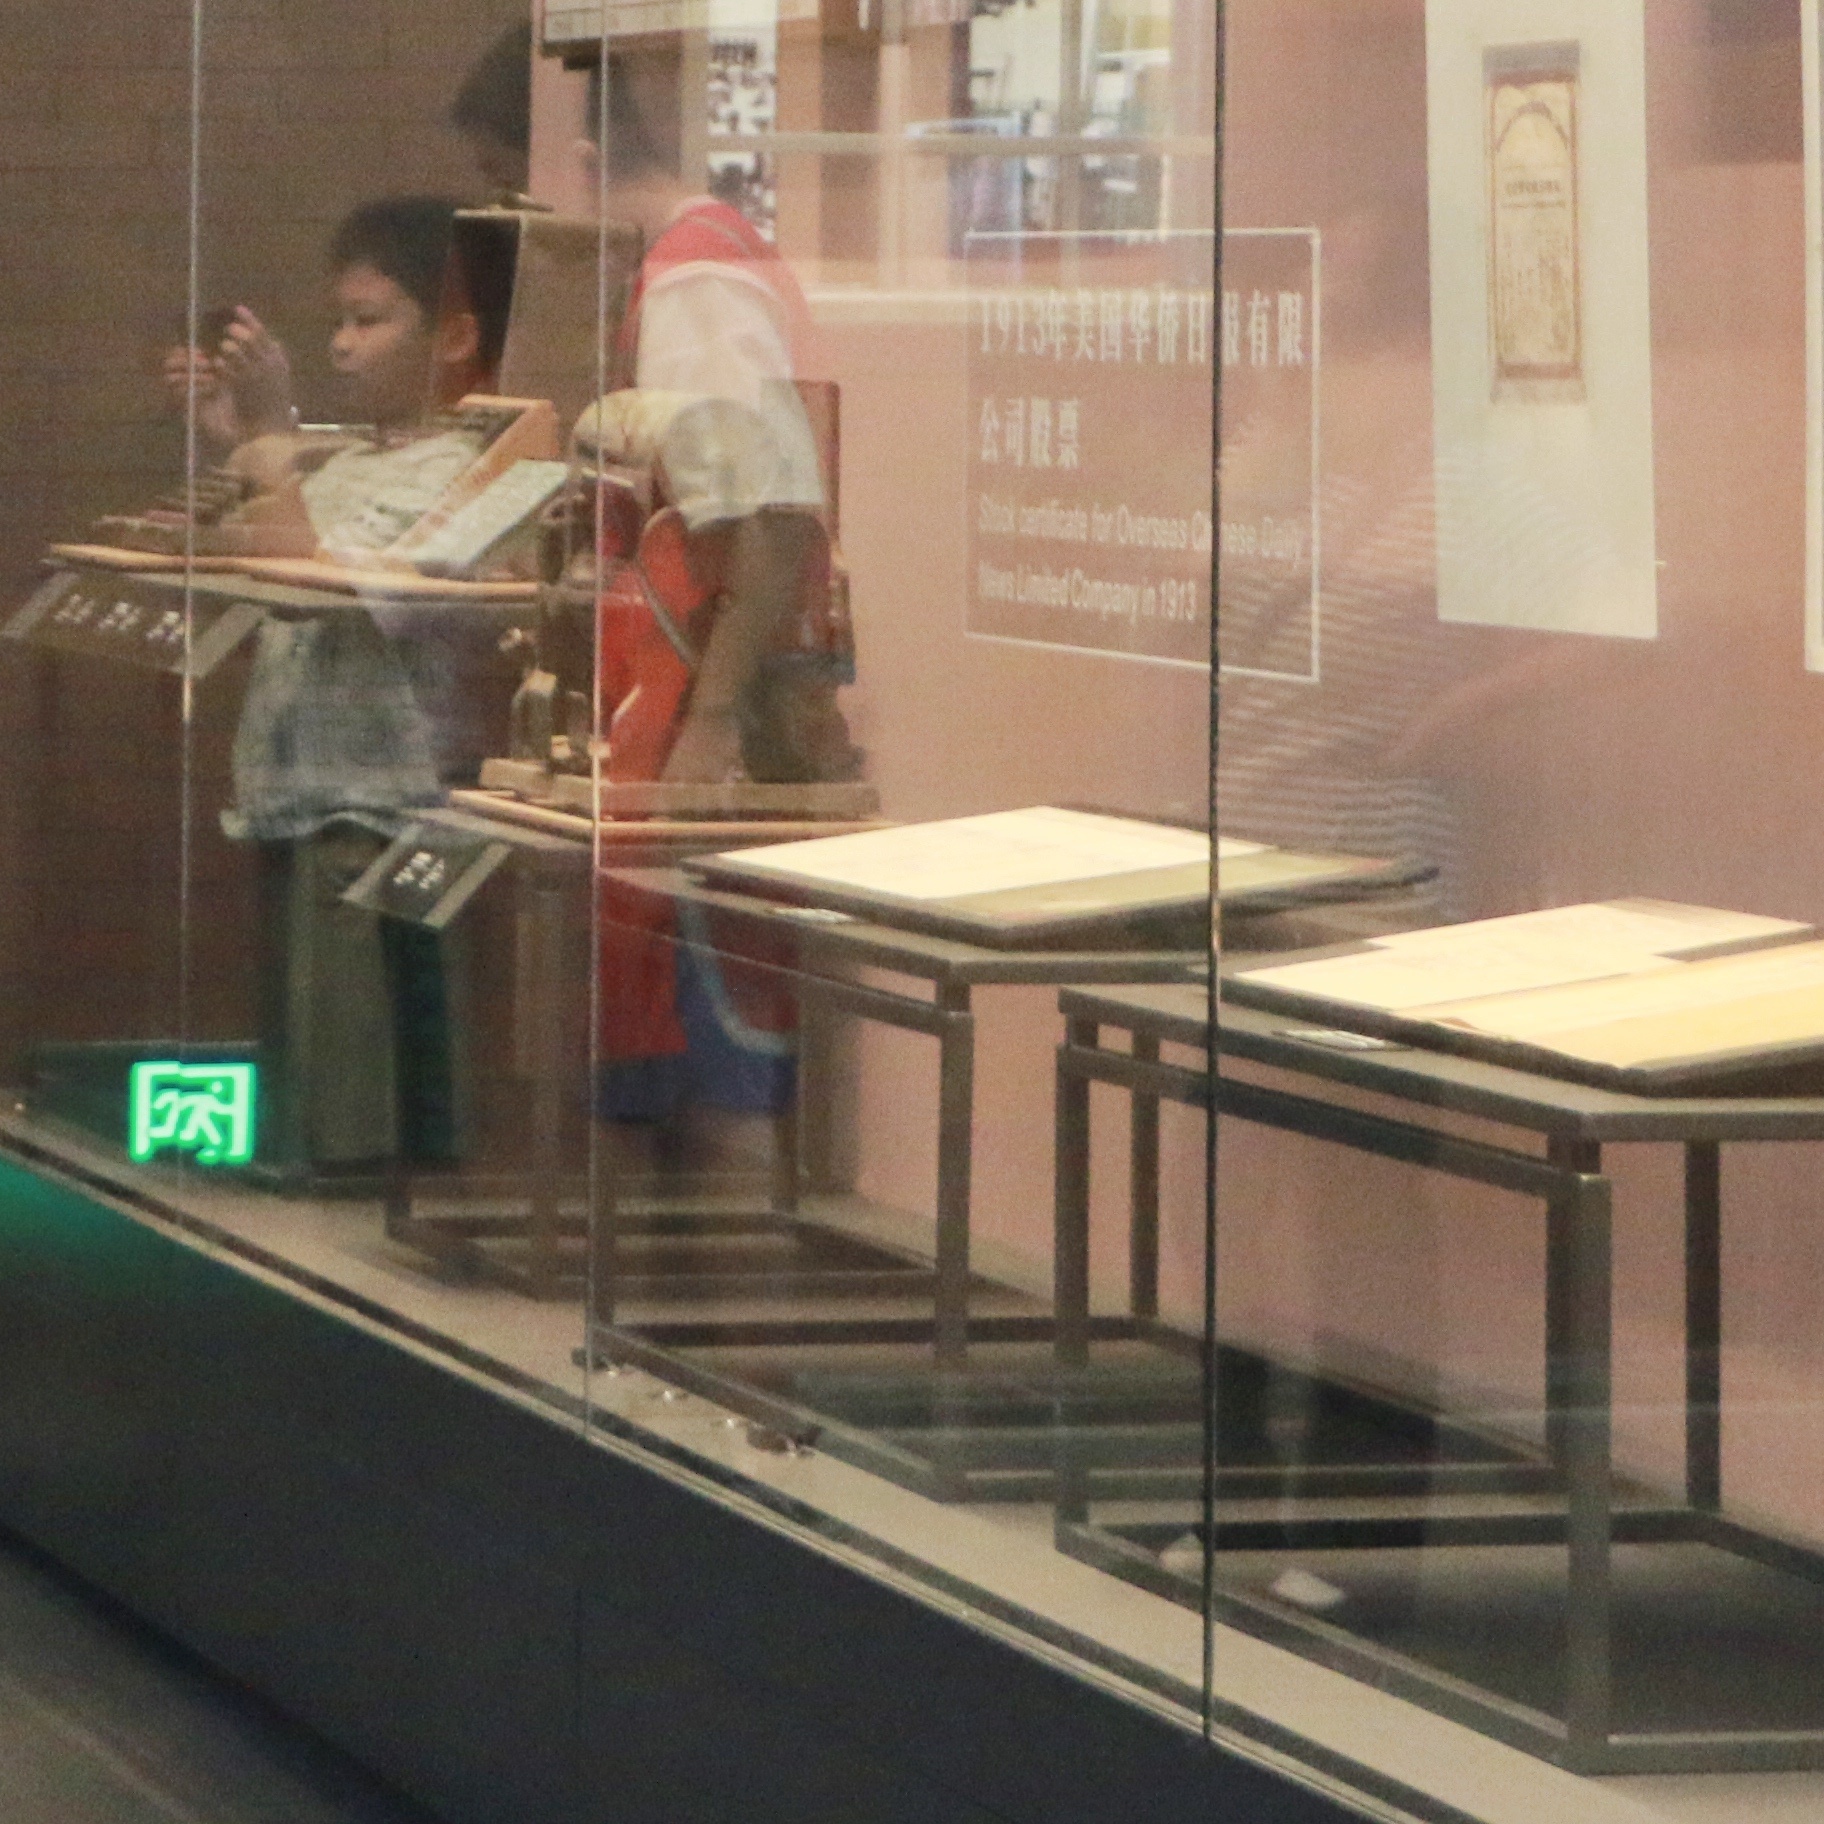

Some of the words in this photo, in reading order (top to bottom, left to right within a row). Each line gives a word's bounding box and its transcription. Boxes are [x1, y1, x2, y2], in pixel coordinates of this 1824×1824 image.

[979, 395, 1081, 470] 公司股票
[1091, 501, 1114, 545] for
[1116, 503, 1188, 552] Overseas
[1261, 516, 1303, 571] Daily
[979, 559, 1015, 602] News
[1017, 562, 1069, 608] Limited
[1071, 567, 1139, 625] Company
[1141, 576, 1157, 618] in
[1160, 577, 1197, 623] 1913
